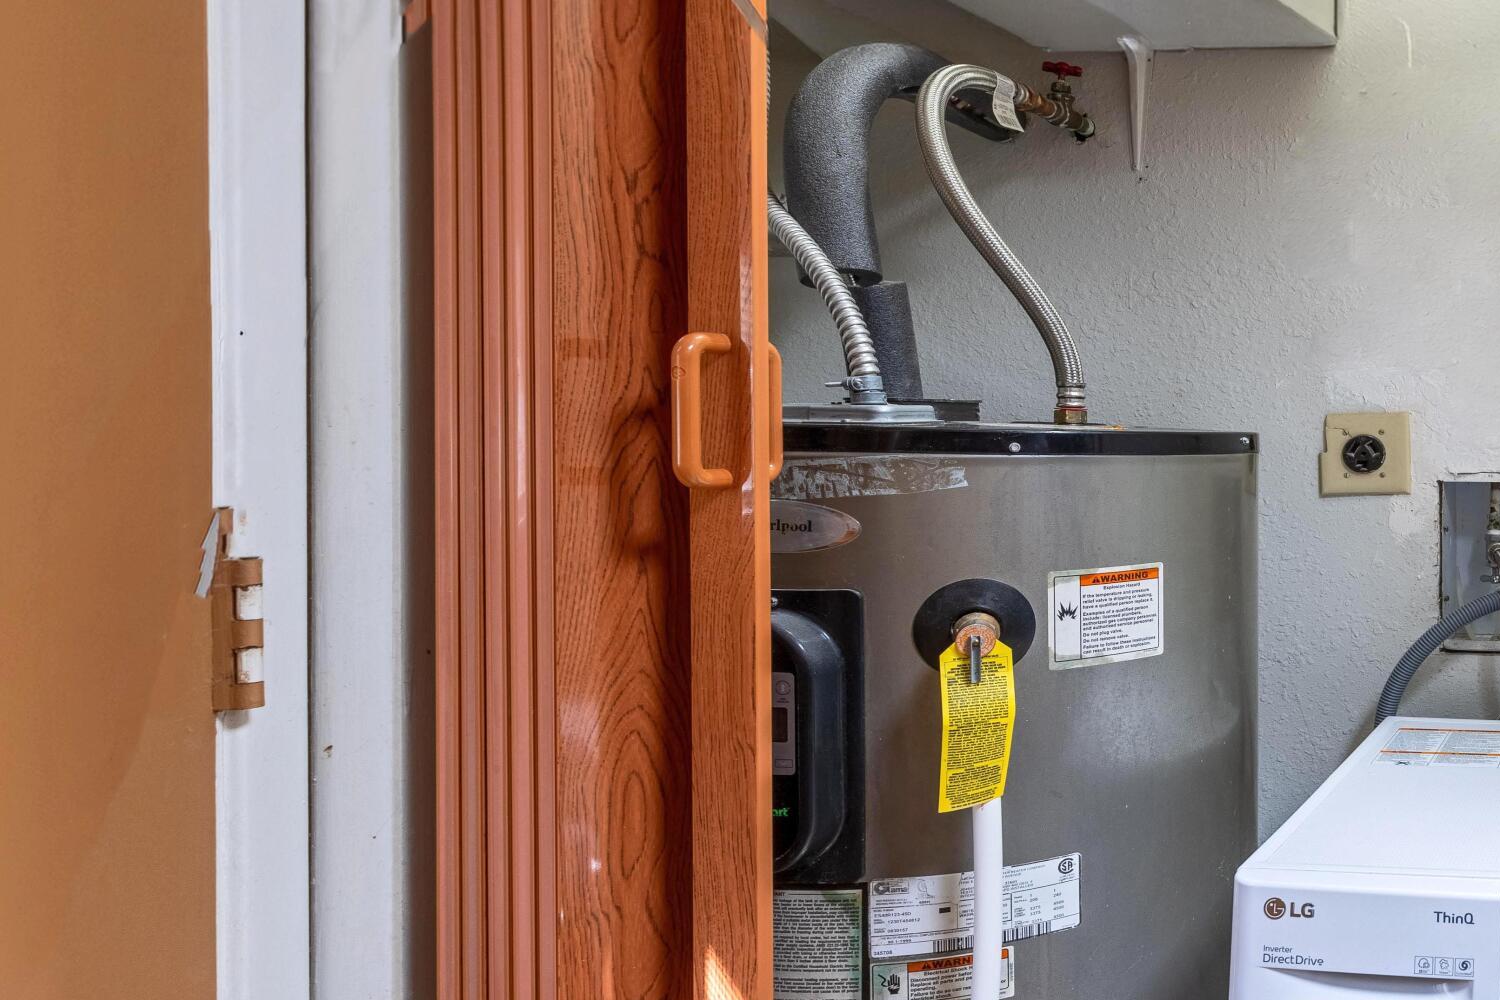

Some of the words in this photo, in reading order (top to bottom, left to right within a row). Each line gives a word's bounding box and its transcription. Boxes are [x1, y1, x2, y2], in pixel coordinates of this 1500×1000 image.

[770, 519, 812, 534] rlpool
[1101, 572, 1148, 582] WARNING
[1290, 902, 1315, 918] LG
[1434, 911, 1475, 924] ThinQ
[1263, 945, 1292, 953] Inverter
[932, 957, 971, 968] WARN
